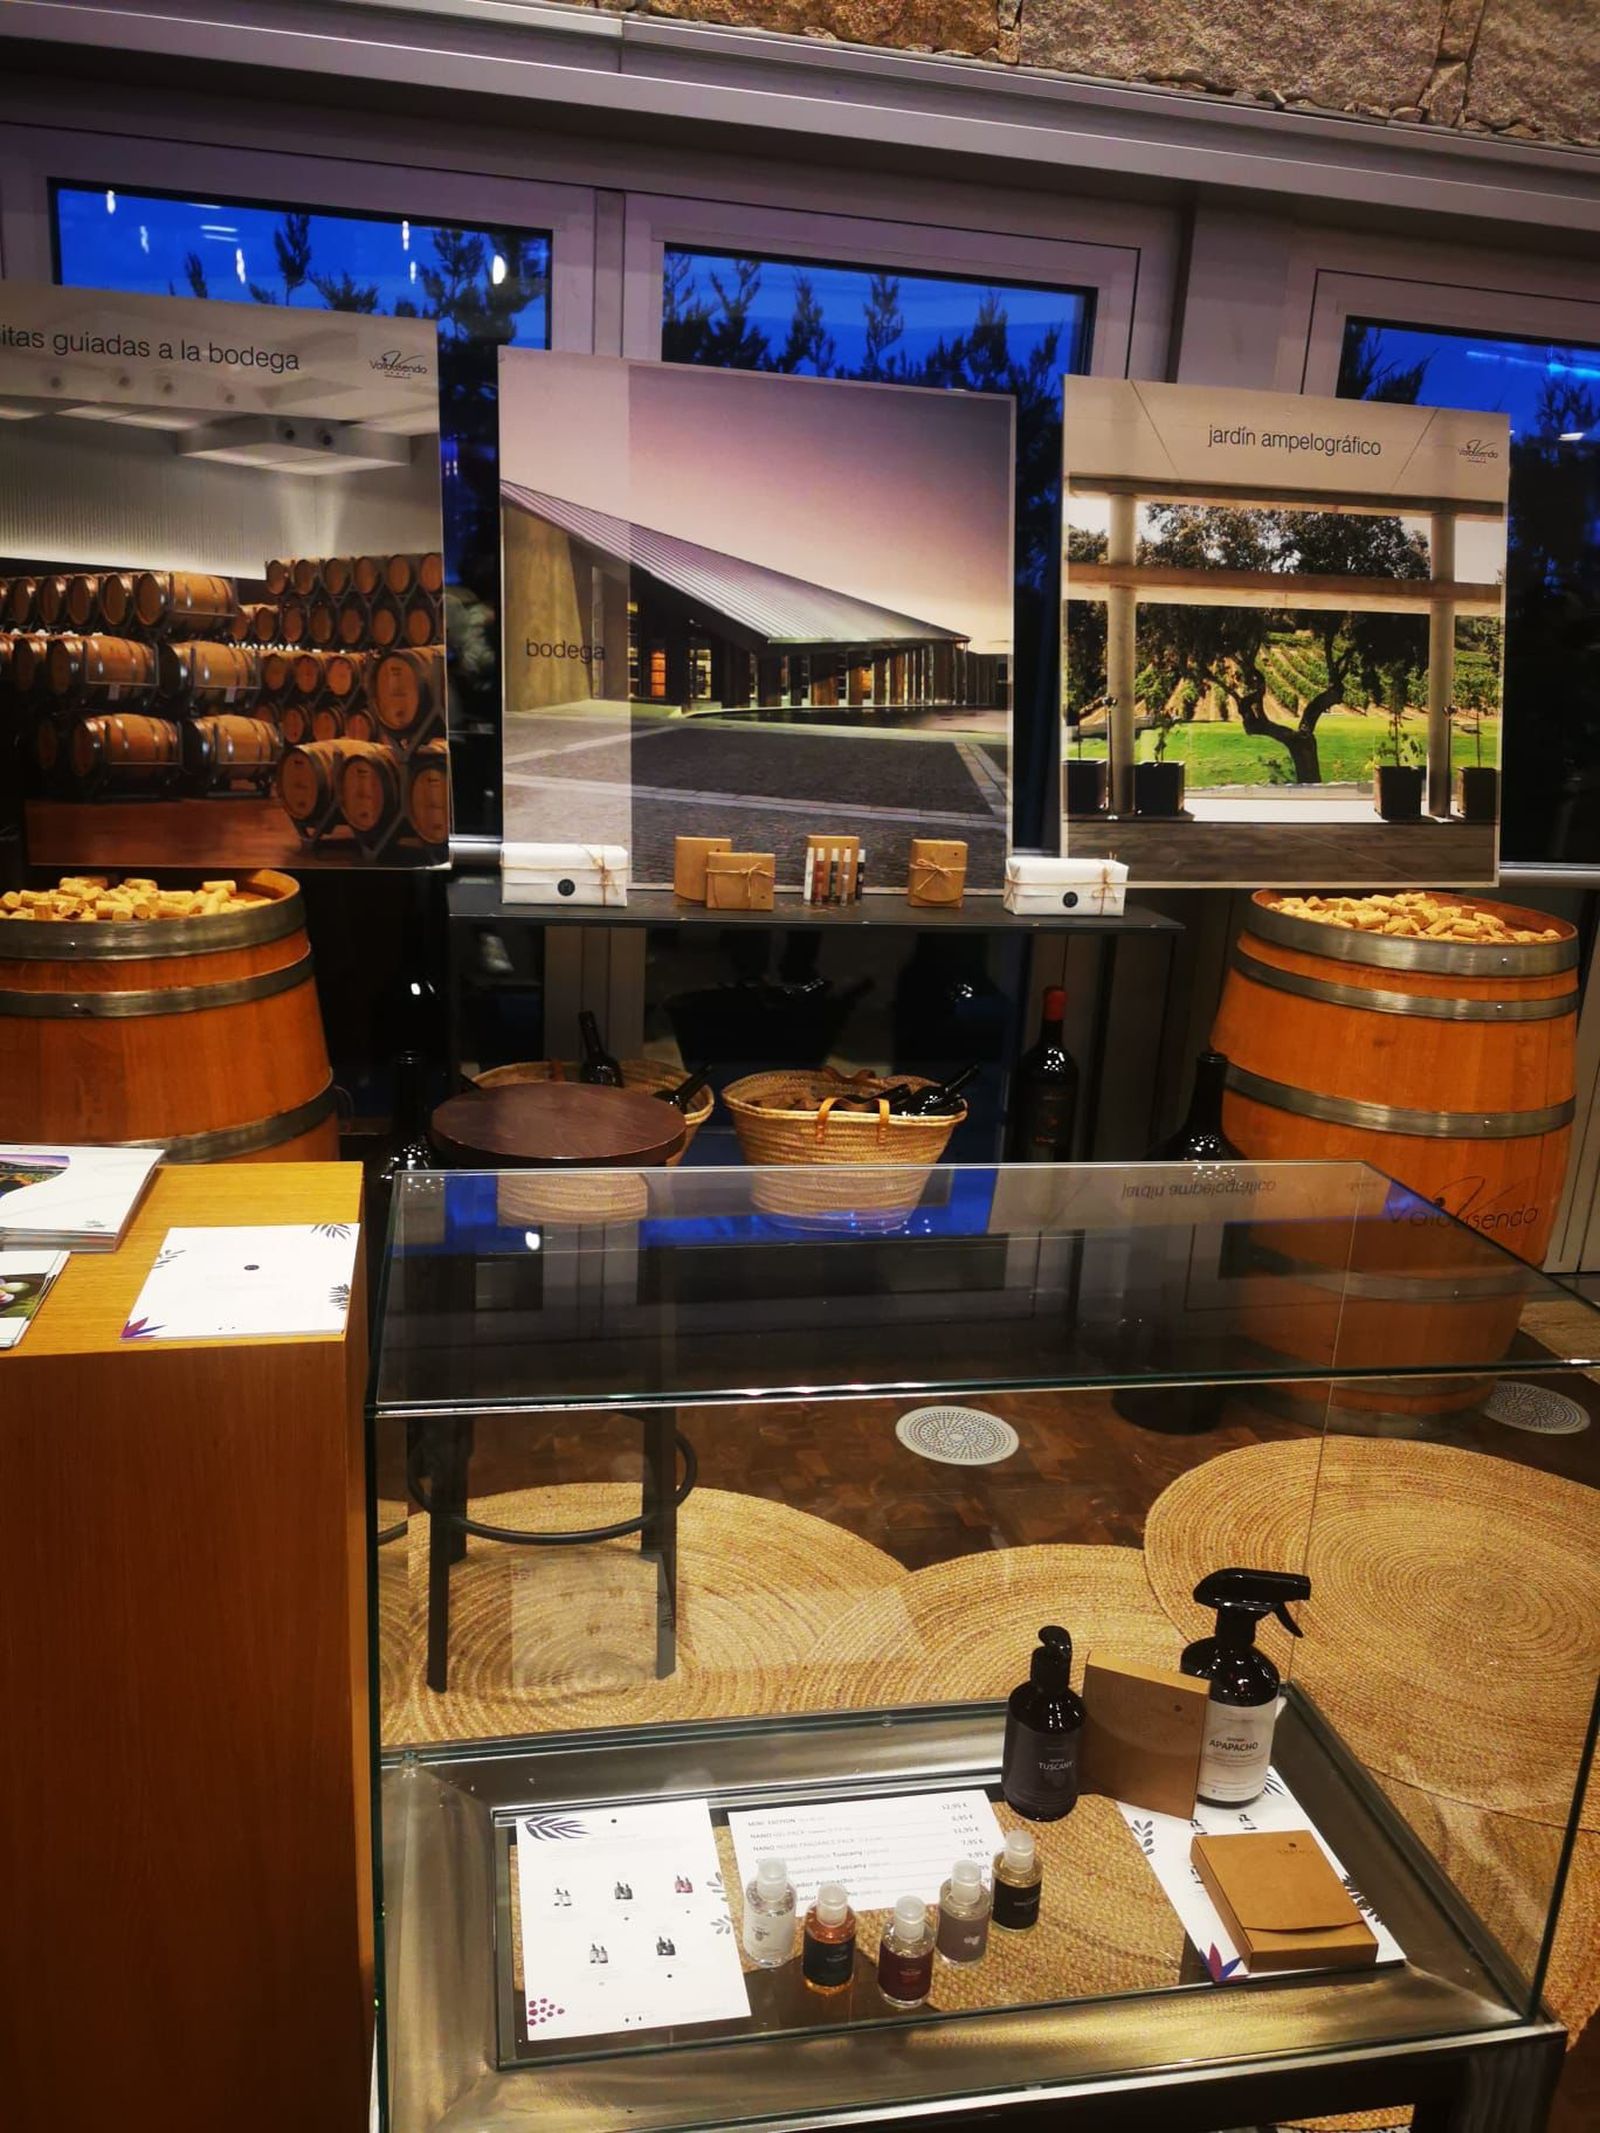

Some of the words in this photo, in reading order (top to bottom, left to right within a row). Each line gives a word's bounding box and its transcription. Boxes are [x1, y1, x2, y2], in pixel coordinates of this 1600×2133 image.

[0, 324, 45, 349] itas
[53, 331, 151, 358] guiadas
[159, 342, 174, 360] a
[181, 339, 201, 363] la
[209, 341, 300, 374] bodega
[1208, 425, 1256, 447] jardín
[1261, 431, 1382, 456] ampelográfico
[526, 638, 606, 664] bodega
[1209, 1739, 1260, 1751] APAPACHO
